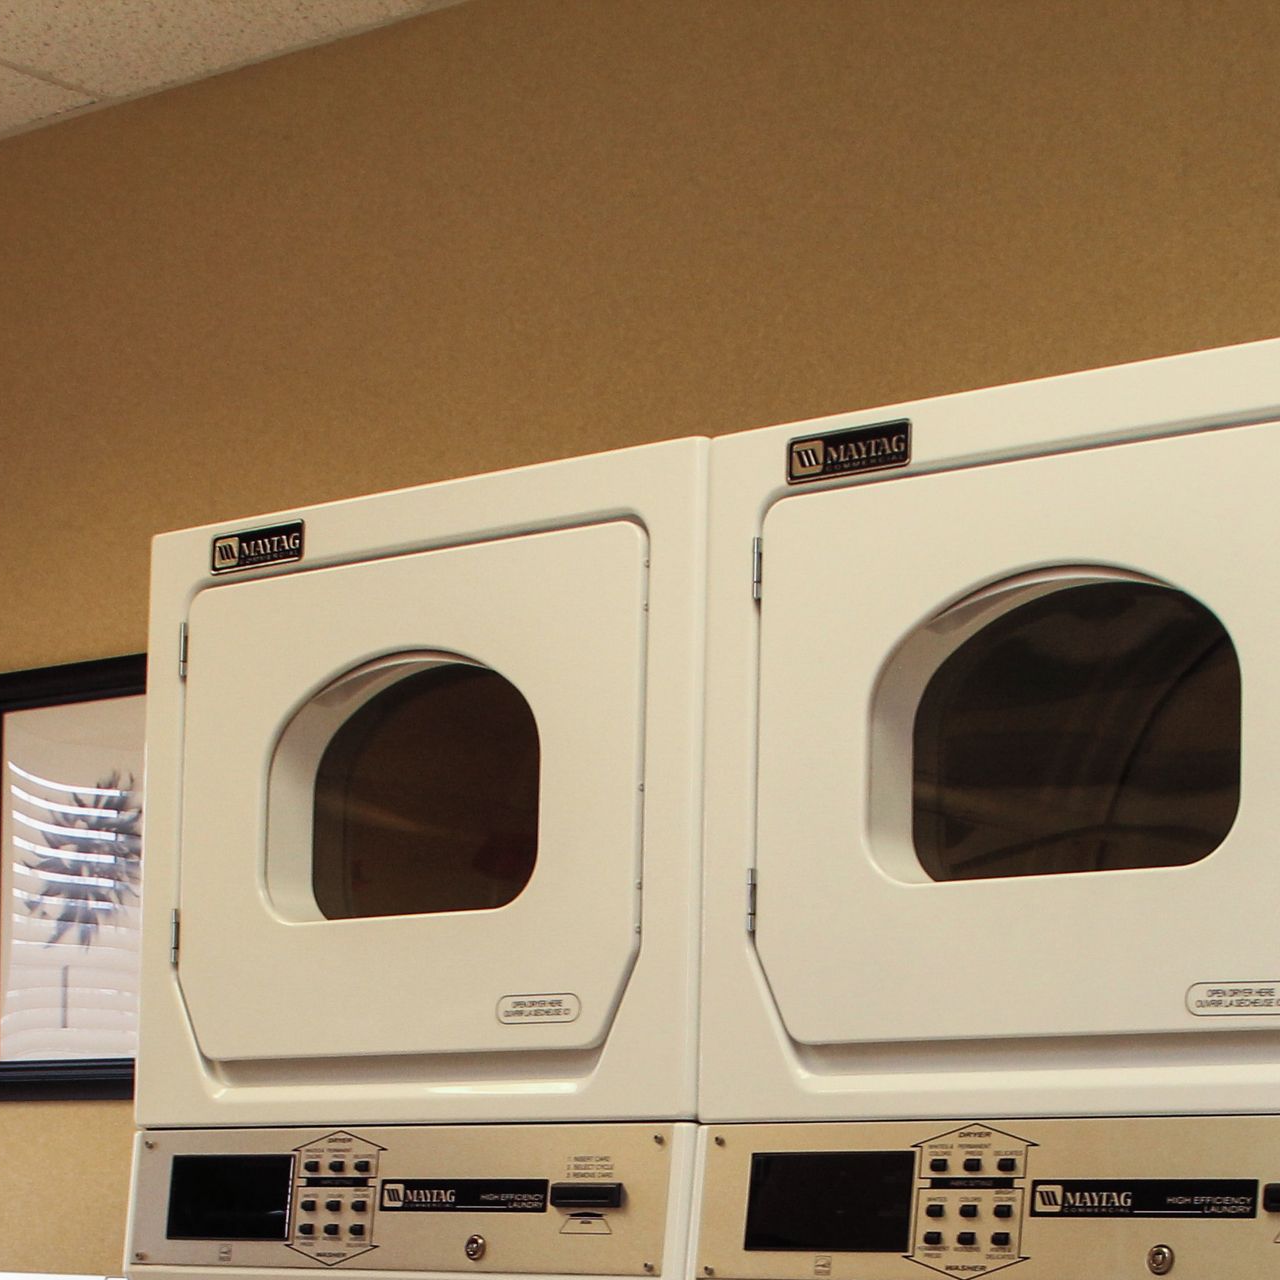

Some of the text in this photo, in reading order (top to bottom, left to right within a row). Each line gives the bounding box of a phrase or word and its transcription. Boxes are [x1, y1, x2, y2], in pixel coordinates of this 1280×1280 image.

[827, 434, 905, 464] MAYTAG
[241, 533, 300, 558] MAYTAG
[404, 1190, 455, 1202] MAYTAG
[1063, 1192, 1132, 1207] MAYTAG
[1166, 1196, 1253, 1205] HIGH EFFICIENCY
[1204, 1206, 1252, 1214] LAUNDRY
